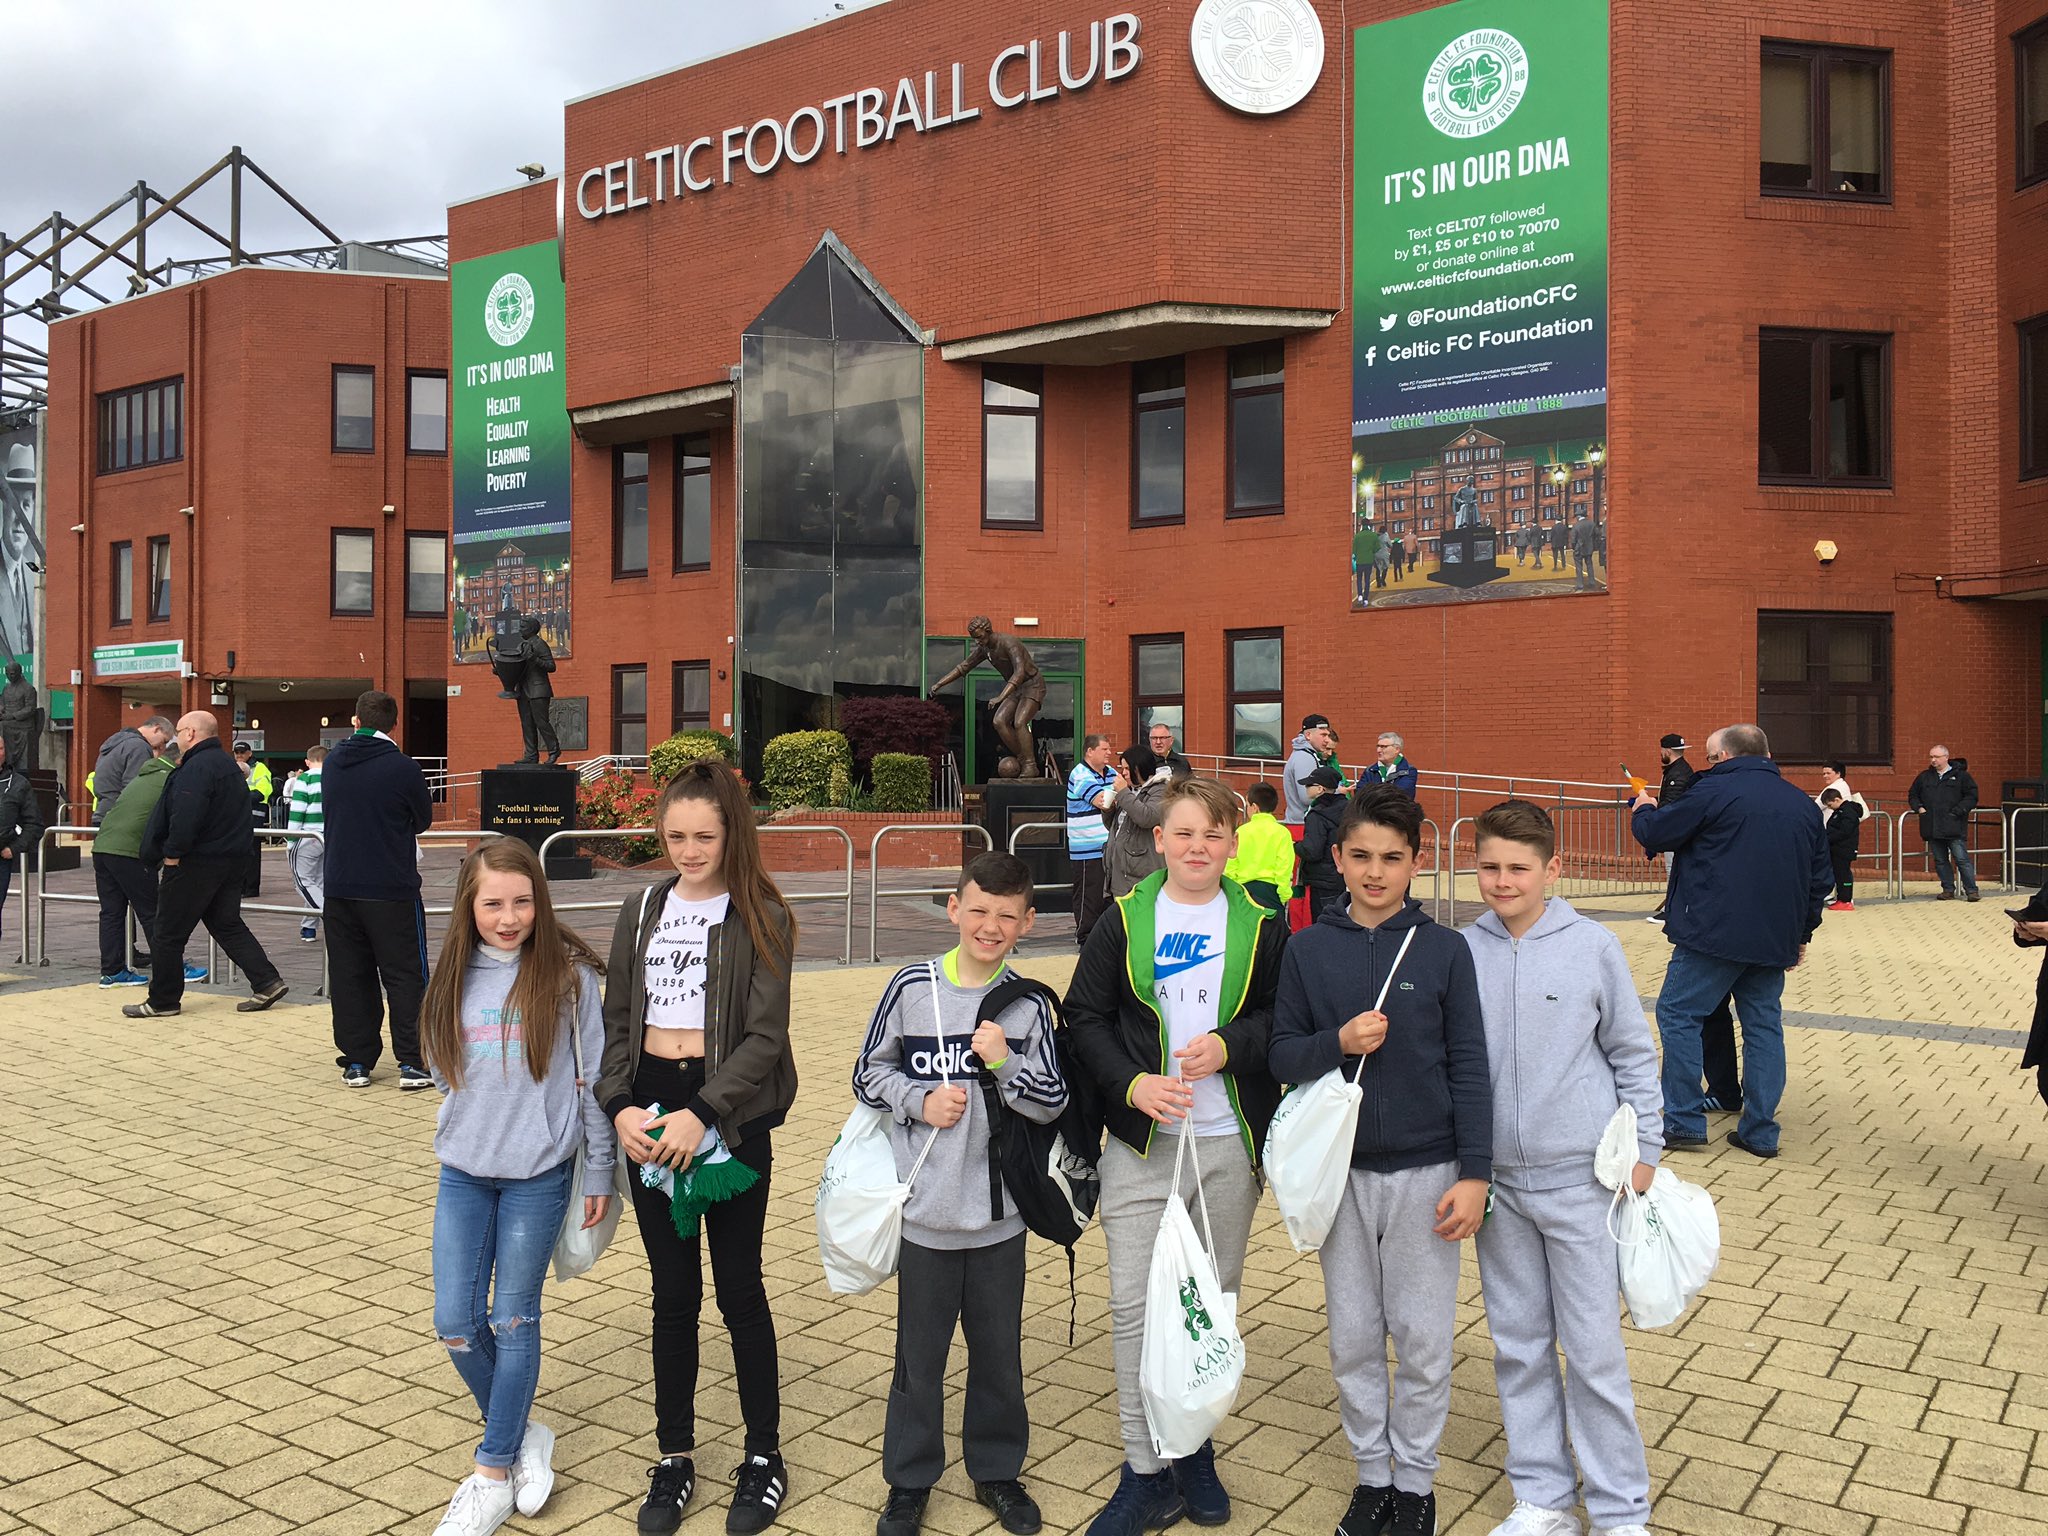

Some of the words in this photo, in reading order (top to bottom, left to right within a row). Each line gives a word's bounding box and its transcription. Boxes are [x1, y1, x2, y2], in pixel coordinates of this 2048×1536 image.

[1428, 50, 1454, 84] CELTIC
[1454, 39, 1467, 54] FC
[1470, 32, 1524, 66] FOUNDATION
[1514, 69, 1525, 82] 88
[1428, 92, 1436, 103] 18
[1430, 107, 1472, 135] FOOTBALL
[1476, 116, 1496, 133] FOR
[1497, 90, 1521, 119] GOOD
[576, 136, 714, 219] CELTIC
[721, 62, 981, 184] FOOTBALL
[989, 13, 1143, 108] CLUB
[1384, 168, 1426, 205] IT'S
[1432, 160, 1456, 195] IN
[1462, 149, 1511, 188] OUR
[1518, 136, 1570, 177] DNA
[1407, 227, 1432, 241] Text
[1435, 214, 1486, 235] CELT07
[1490, 203, 1545, 225] followed
[1394, 248, 1409, 261] by
[1412, 244, 1432, 257] £1,
[1435, 239, 1451, 252] £5
[1454, 237, 1470, 249] or
[1472, 230, 1497, 245] £10
[1500, 228, 1514, 241] to
[1518, 218, 1560, 237] 70070
[1416, 261, 1429, 273] or
[1432, 254, 1476, 270] donate
[1480, 245, 1518, 261] online
[1522, 240, 1535, 253] at
[1381, 252, 1574, 296] www.celticfcfoundation.com
[1407, 284, 1578, 327] @FoundationCFC
[1387, 339, 1441, 362] Celtic
[1446, 334, 1473, 353] FC
[1479, 317, 1593, 348] Foundation
[467, 363, 488, 387] IT'S
[489, 361, 501, 383] IN
[503, 356, 527, 380] OUR
[530, 351, 554, 377] DNA
[486, 396, 520, 417] HEALTH
[1390, 417, 1425, 430] CELTIC
[1433, 408, 1489, 425] FOOTBALL
[1498, 402, 1528, 415] CLUB
[1537, 398, 1563, 411] 1888
[486, 420, 529, 442] EQUALITY
[486, 446, 530, 468] LEARNING
[486, 472, 527, 493] POVERTY
[493, 816, 504, 824] the
[507, 816, 522, 824] fans
[525, 816, 531, 824] is
[534, 816, 564, 825] nothing"
[498, 804, 530, 812] "Football
[655, 936, 703, 945] Downtown
[1156, 932, 1211, 960] NIKE
[656, 977, 684, 988] 1998
[1159, 984, 1208, 1004] AIR
